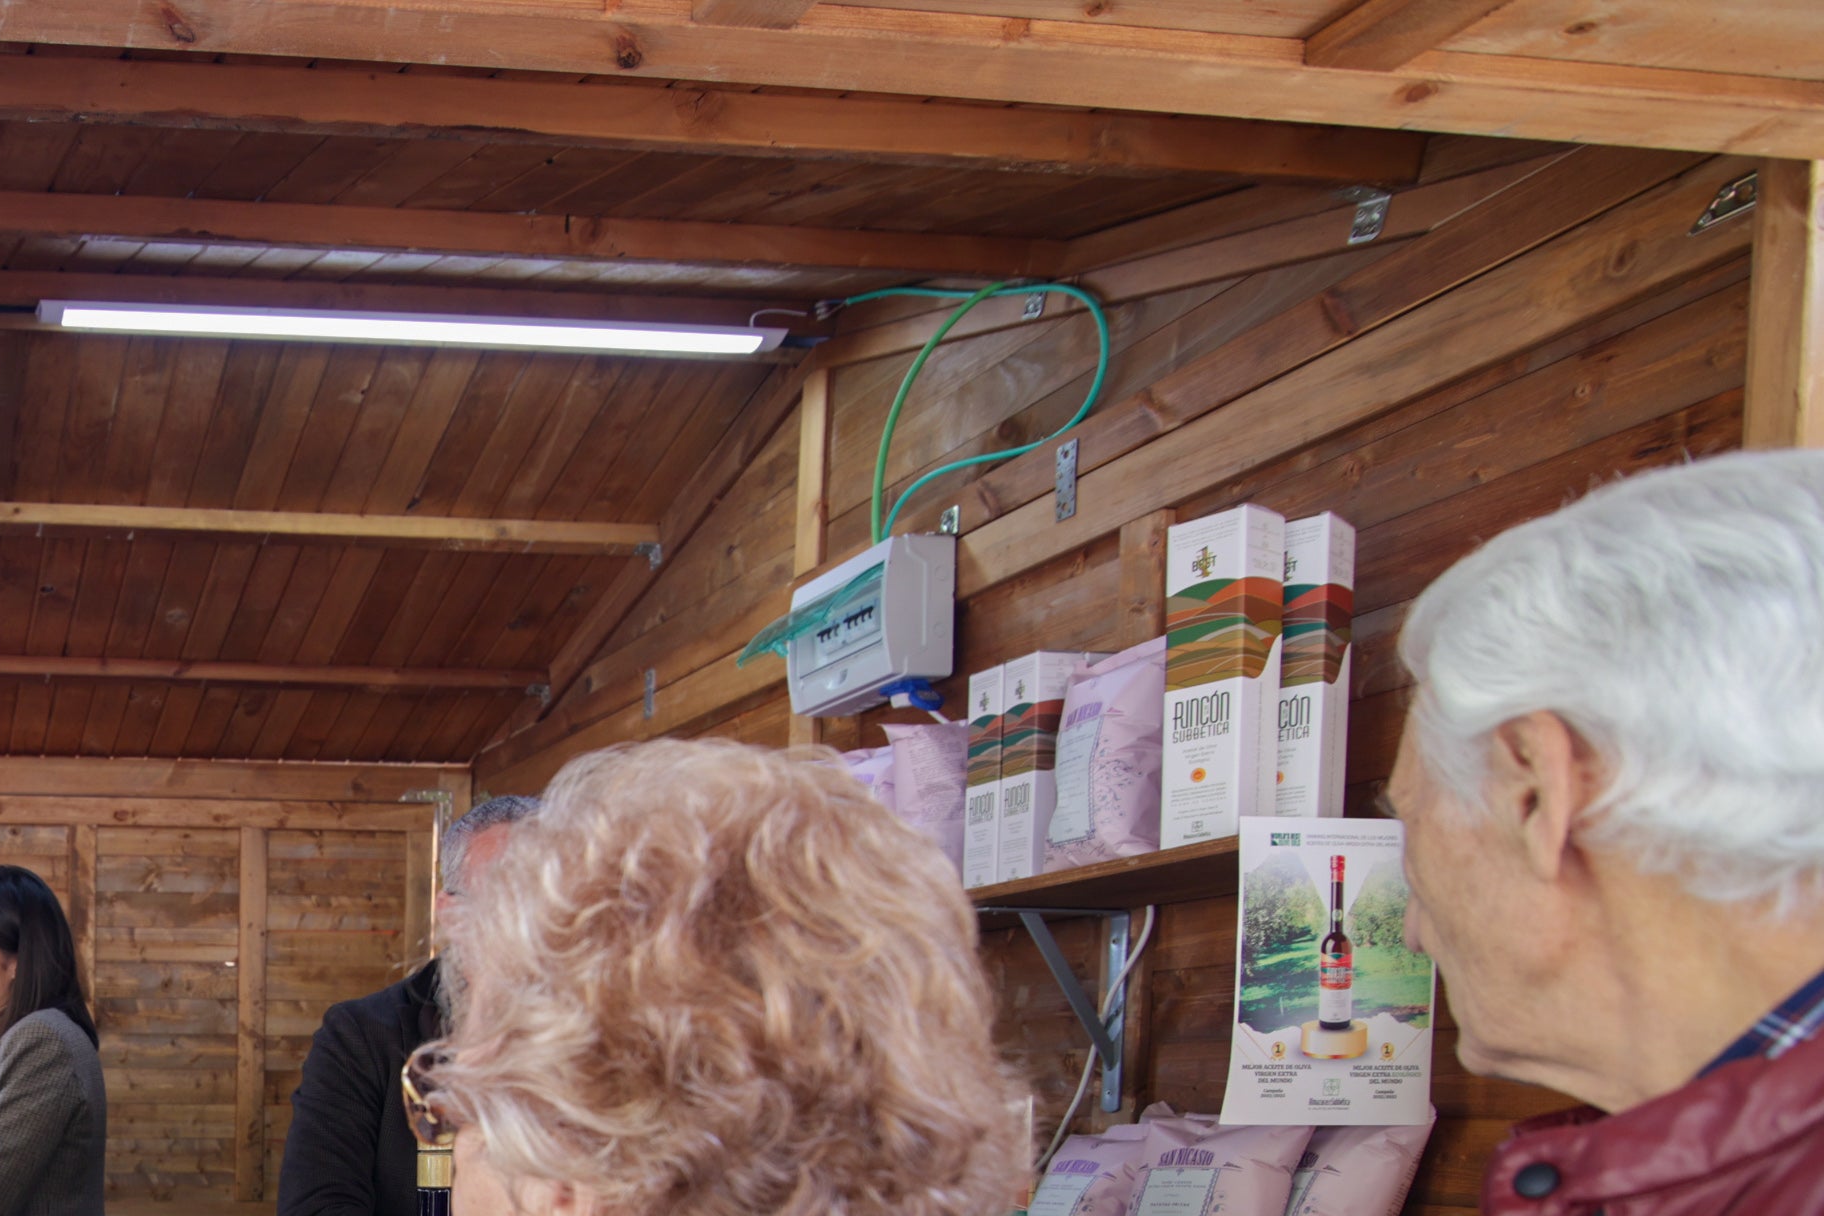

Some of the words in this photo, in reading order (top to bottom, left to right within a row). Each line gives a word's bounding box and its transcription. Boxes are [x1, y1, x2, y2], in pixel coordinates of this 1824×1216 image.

[1173, 690, 1230, 730] RINCÓN
[1279, 694, 1310, 729] CÓN
[1384, 1045, 1390, 1054] 1
[1158, 1150, 1177, 1166] SAN
[1176, 1148, 1214, 1165] NICASIO
